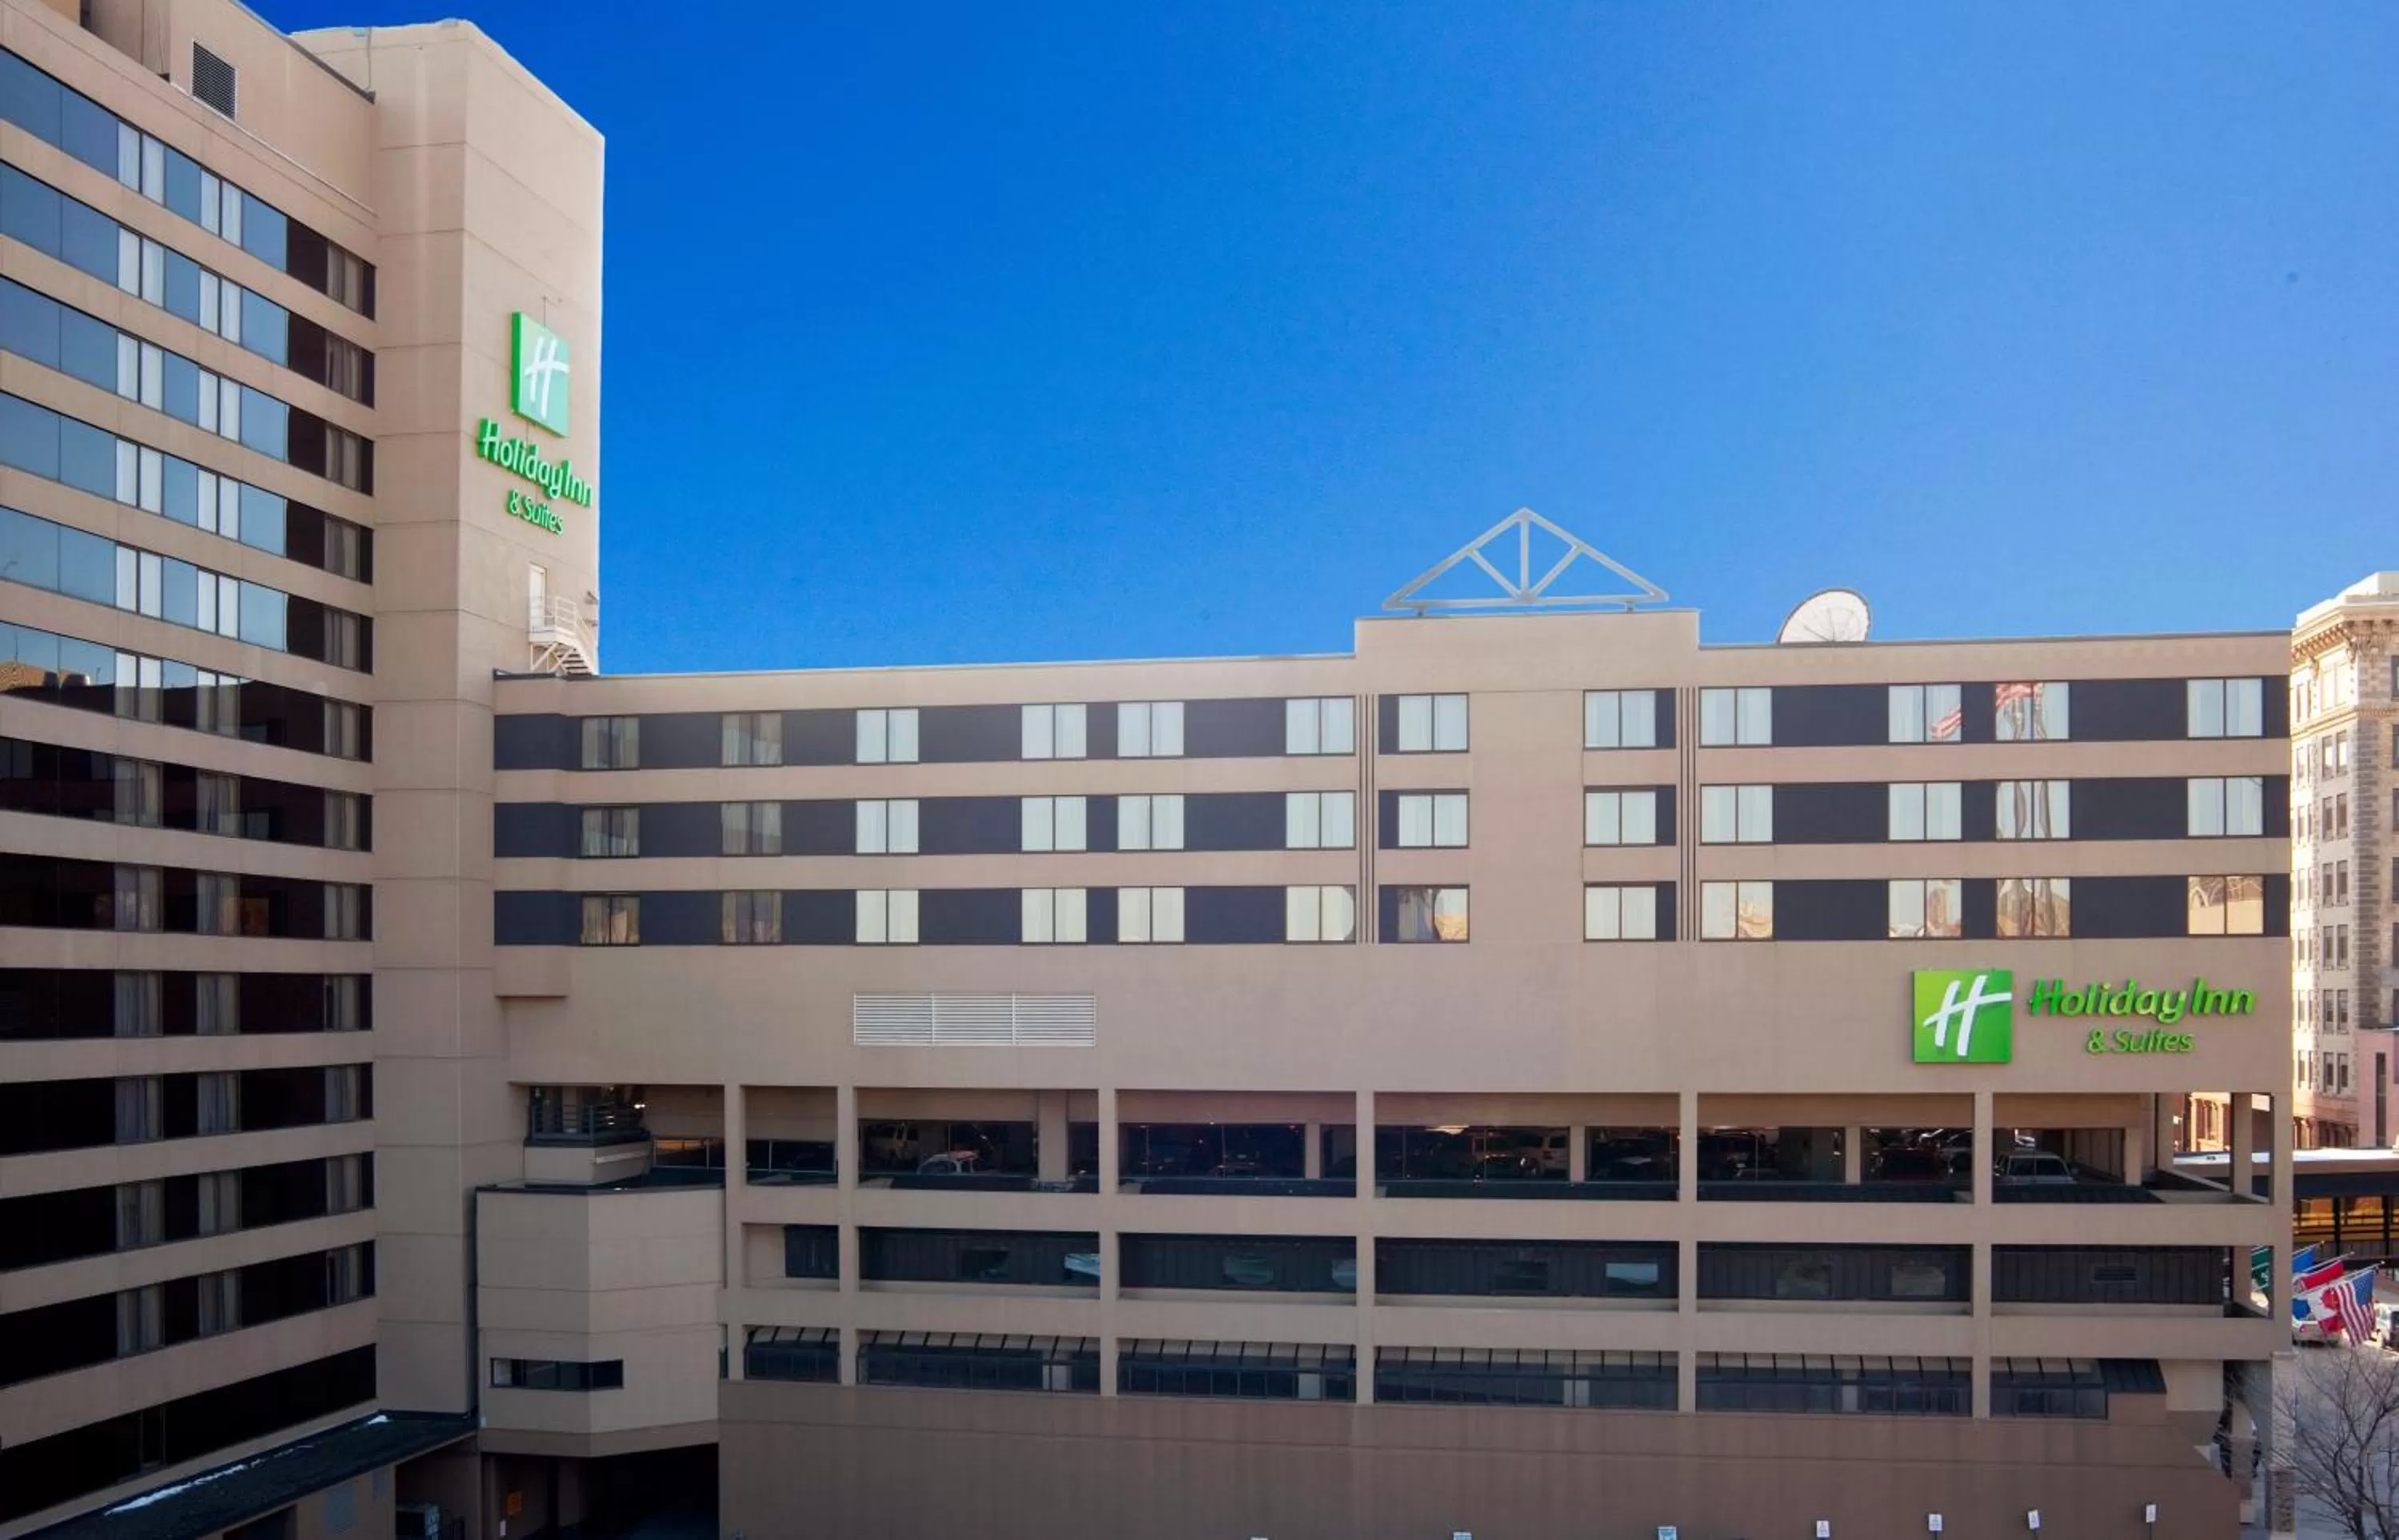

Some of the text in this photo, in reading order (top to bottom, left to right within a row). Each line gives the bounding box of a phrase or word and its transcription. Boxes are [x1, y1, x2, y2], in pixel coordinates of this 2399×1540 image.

[506, 489, 565, 537] & Suites
[2087, 1028, 2195, 1054] & Suites
